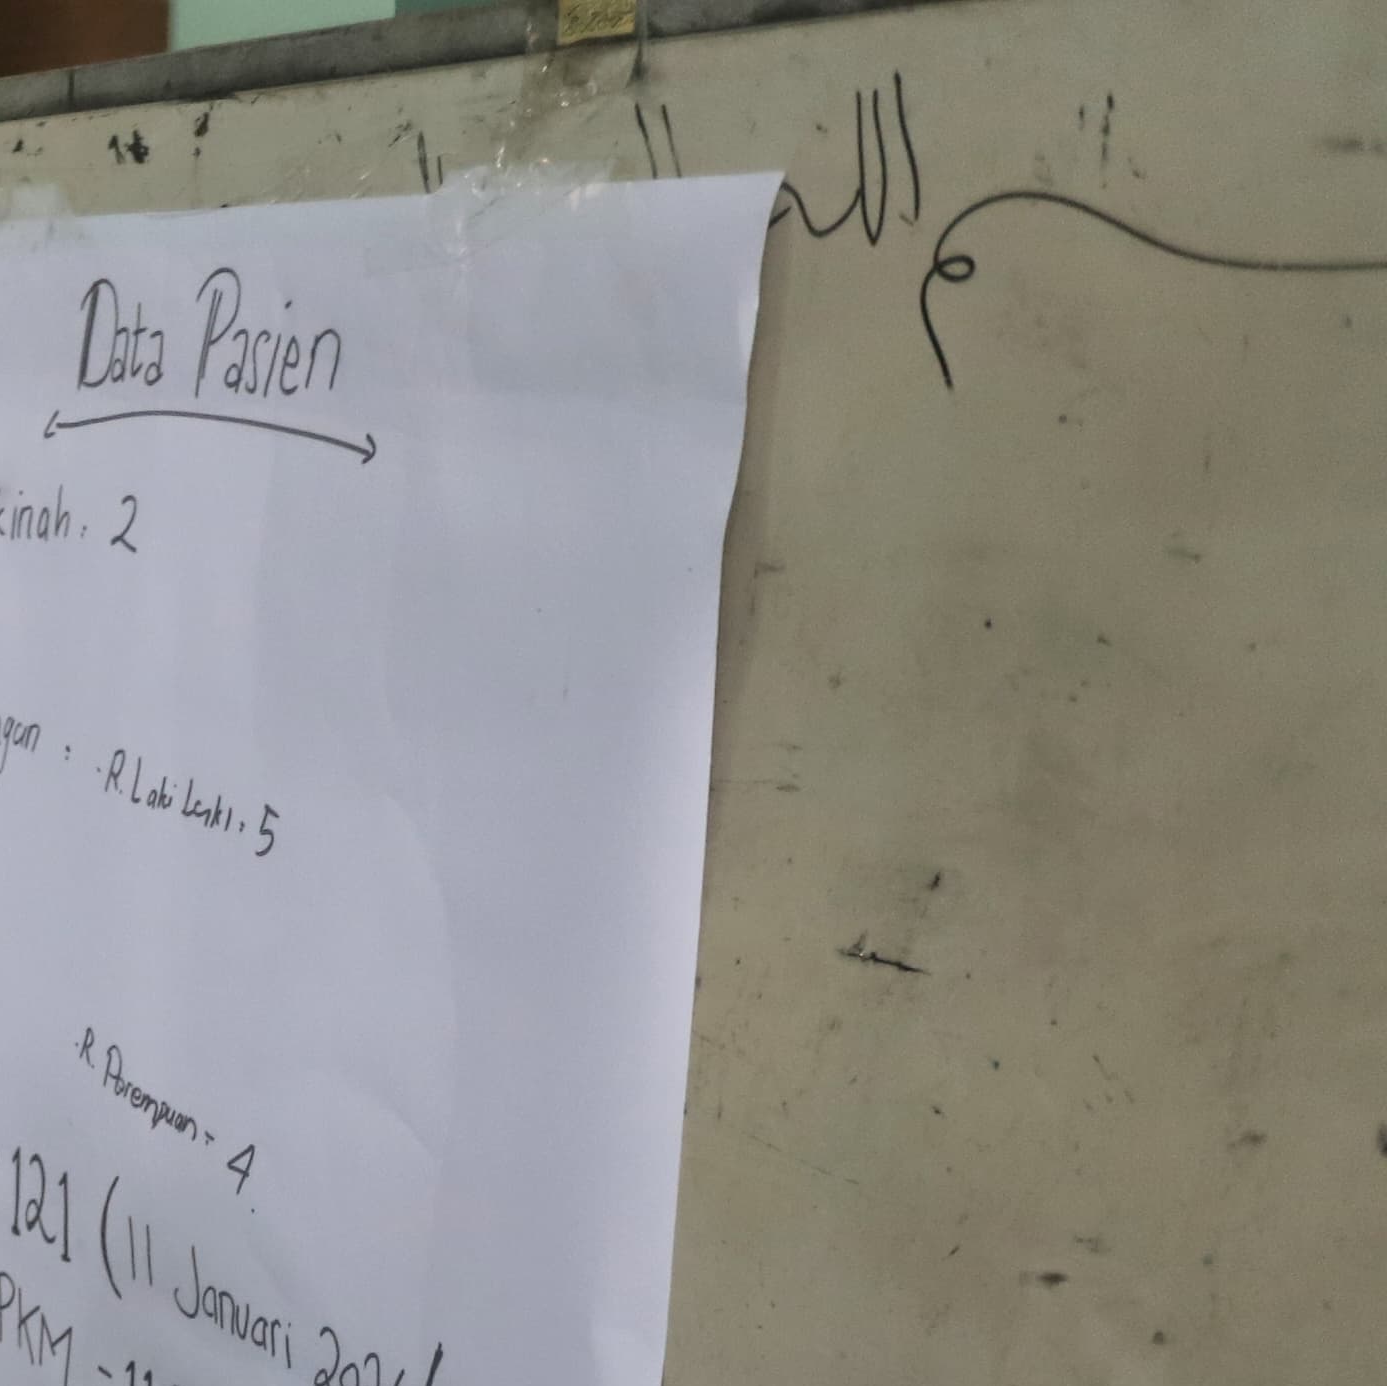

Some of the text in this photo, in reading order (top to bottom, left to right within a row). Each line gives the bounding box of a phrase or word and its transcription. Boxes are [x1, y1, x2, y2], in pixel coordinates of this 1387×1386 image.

[78, 268, 342, 400] Data Pasien
[110, 494, 137, 553] 2
[255, 803, 280, 857] 5
[227, 1144, 255, 1195] 4
[11, 1147, 71, 1263] 121
[173, 1246, 293, 1370] Januari
